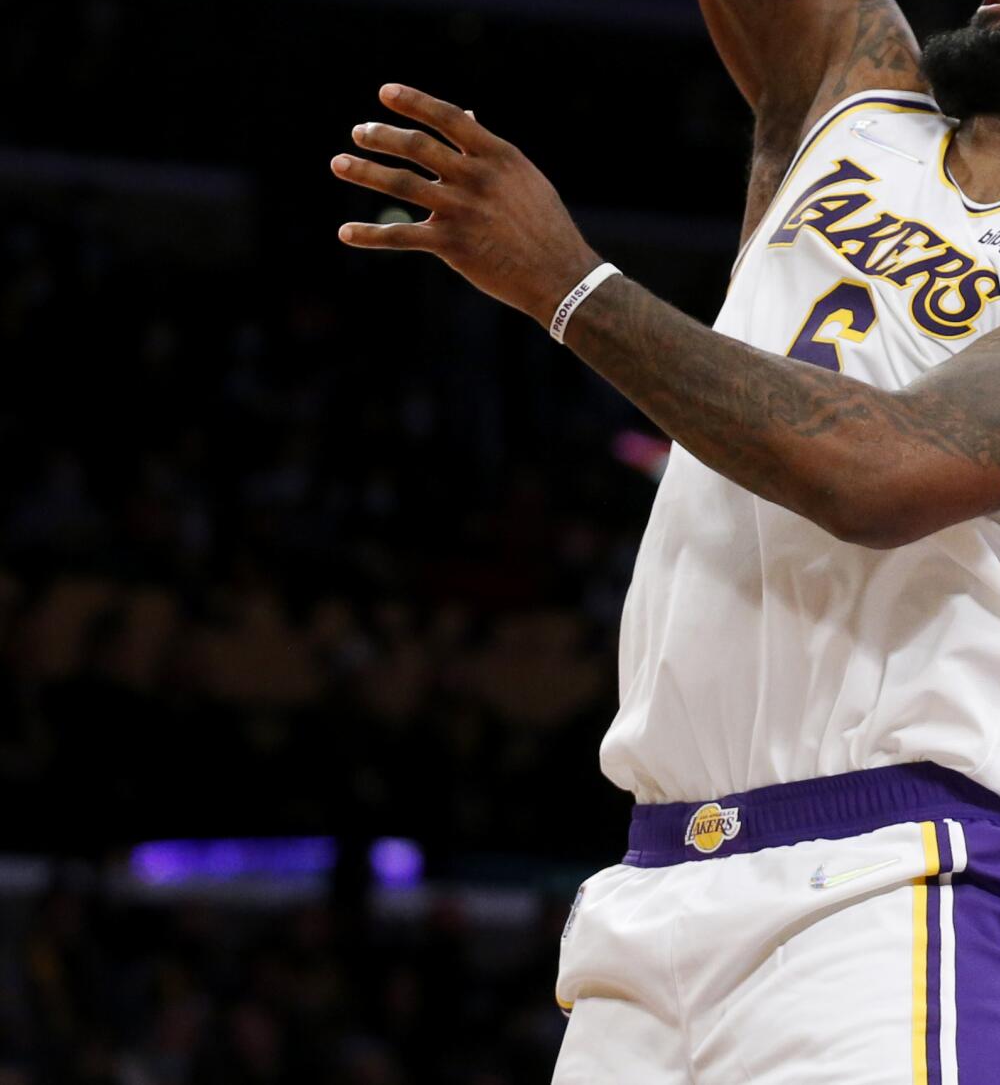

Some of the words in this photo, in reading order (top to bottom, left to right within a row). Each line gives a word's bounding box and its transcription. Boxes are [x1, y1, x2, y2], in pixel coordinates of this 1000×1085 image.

[768, 156, 1000, 340] LAKERS
[552, 282, 591, 333] PROMISE
[687, 816, 736, 841] LAKERS
